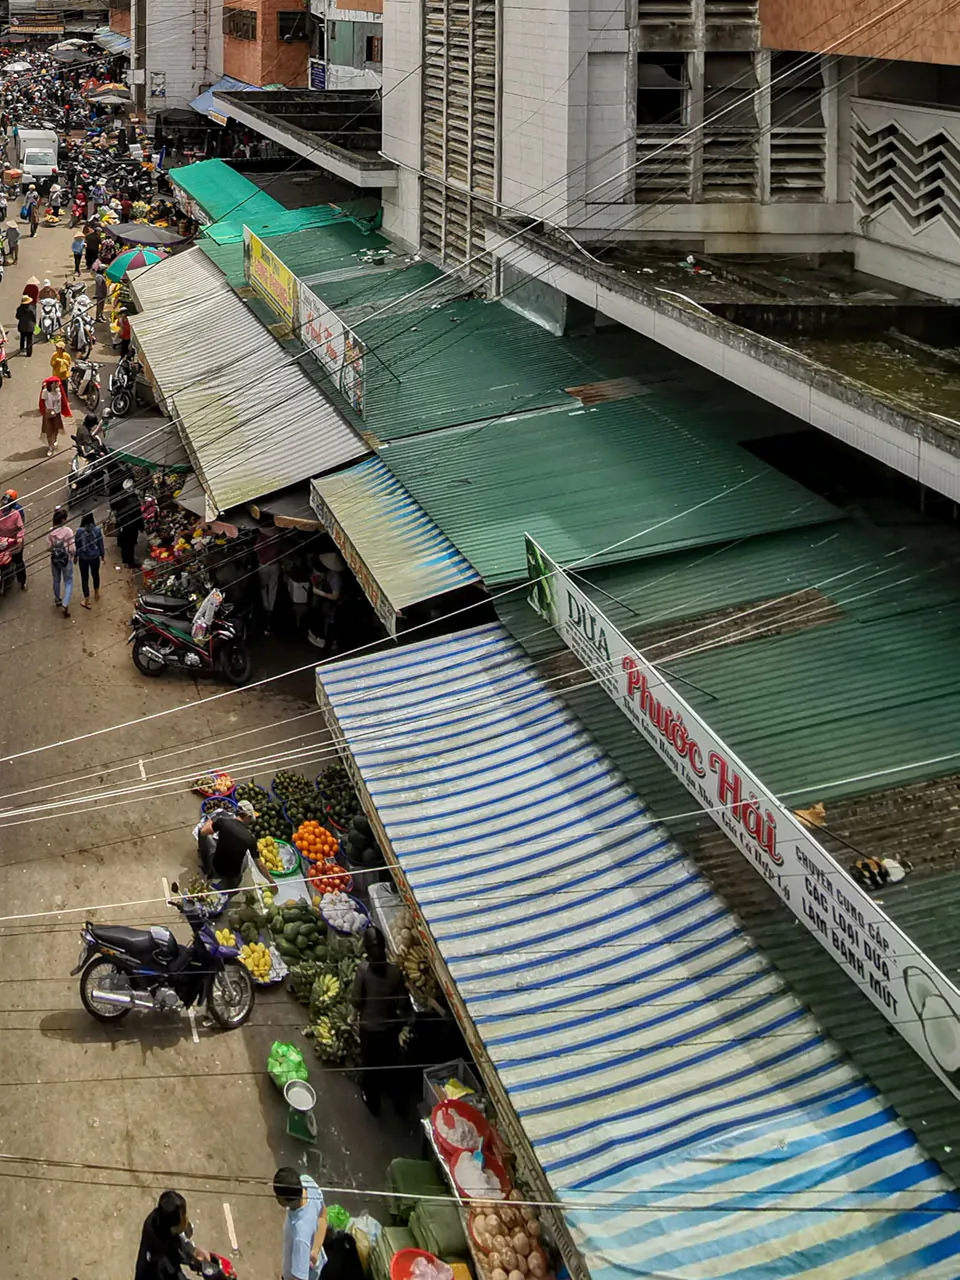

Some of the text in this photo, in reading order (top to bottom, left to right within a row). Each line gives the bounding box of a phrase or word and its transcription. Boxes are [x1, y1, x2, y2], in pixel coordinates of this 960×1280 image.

[567, 589, 611, 661] DỪA
[622, 656, 784, 866] Phước Hải
[796, 843, 832, 895] CHUYÊN
[836, 886, 864, 929] CUNG
[805, 874, 827, 914] CÁC
[832, 903, 859, 949] LOẠI
[802, 895, 897, 1017] LÀM BÁNH MỨT
